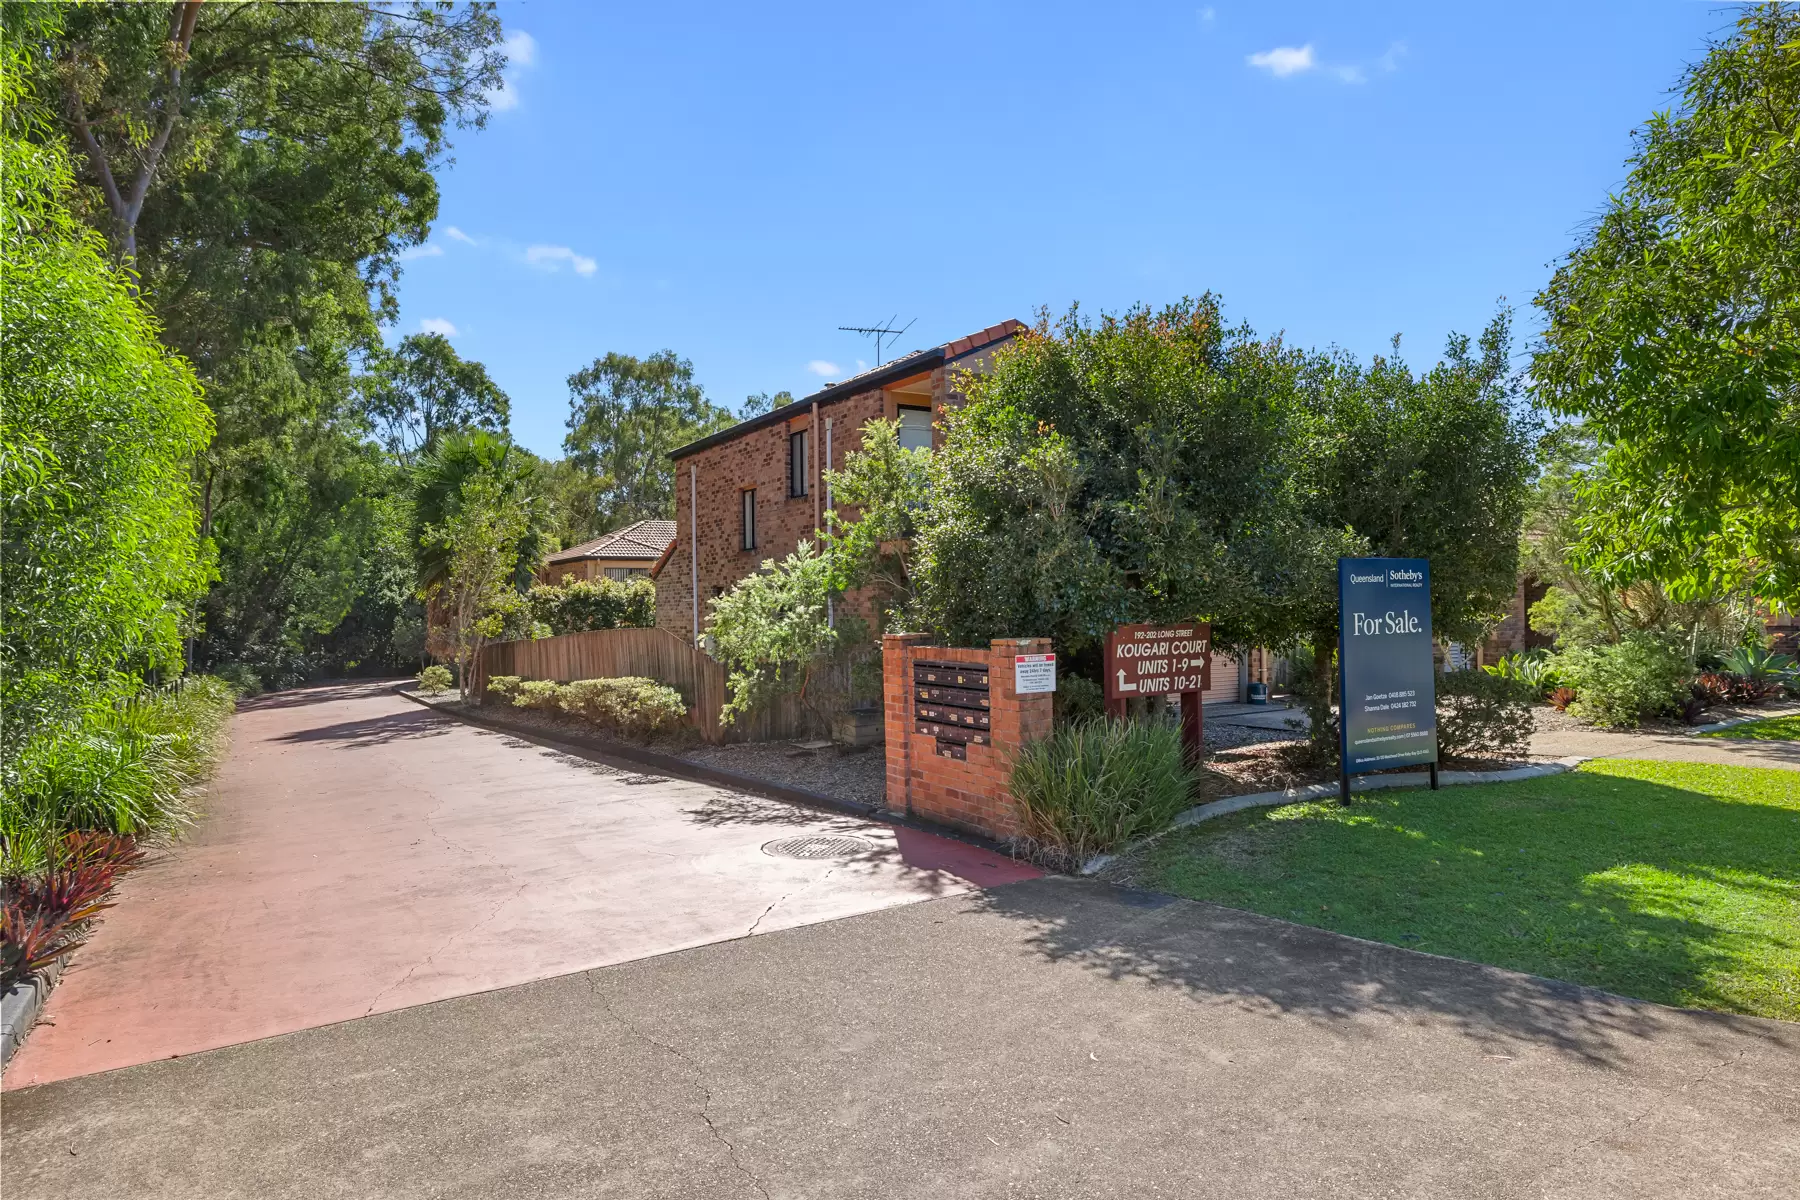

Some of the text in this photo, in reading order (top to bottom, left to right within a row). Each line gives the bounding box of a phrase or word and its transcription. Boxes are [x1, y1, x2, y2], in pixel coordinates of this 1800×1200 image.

[1350, 573, 1384, 584] Queensland
[1390, 569, 1423, 582] Sotheby's
[1352, 609, 1423, 636] For Sale.
[1134, 629, 1193, 639] 192-202 LONG STREET
[1116, 640, 1208, 658] KOUGARI COURT
[1137, 658, 1189, 675] UNITS 1-9
[1139, 674, 1202, 693] UNITS 10-21
[1367, 723, 1416, 734] NOTHING COMPARES
